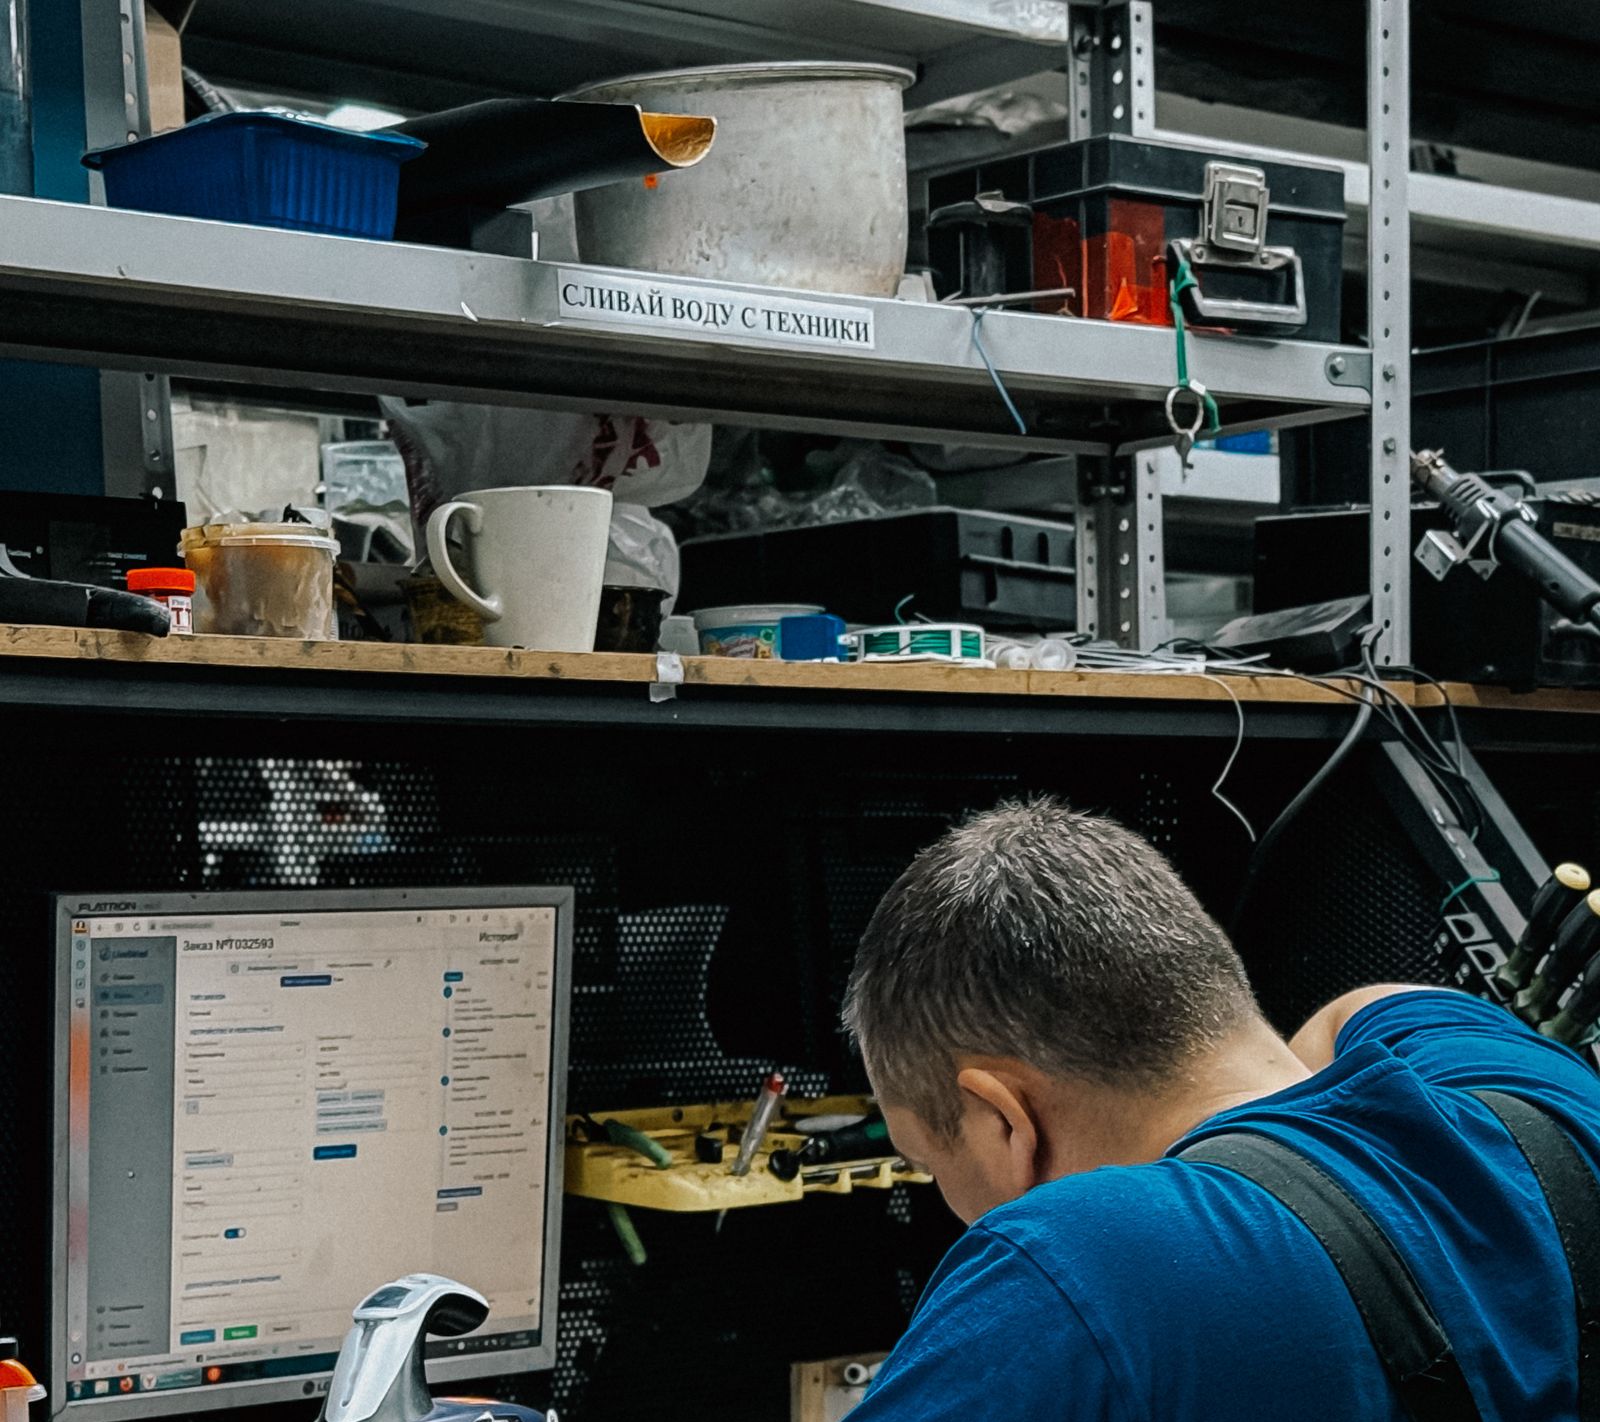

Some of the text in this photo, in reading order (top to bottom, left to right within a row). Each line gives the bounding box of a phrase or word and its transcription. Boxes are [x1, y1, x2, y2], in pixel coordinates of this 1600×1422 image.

[562, 283, 871, 344] СЛИВАЙ ВОДУ С ТЕХНИКИ
[78, 902, 137, 913] FLATRON
[479, 932, 520, 942] История
[183, 940, 213, 951] Заказ
